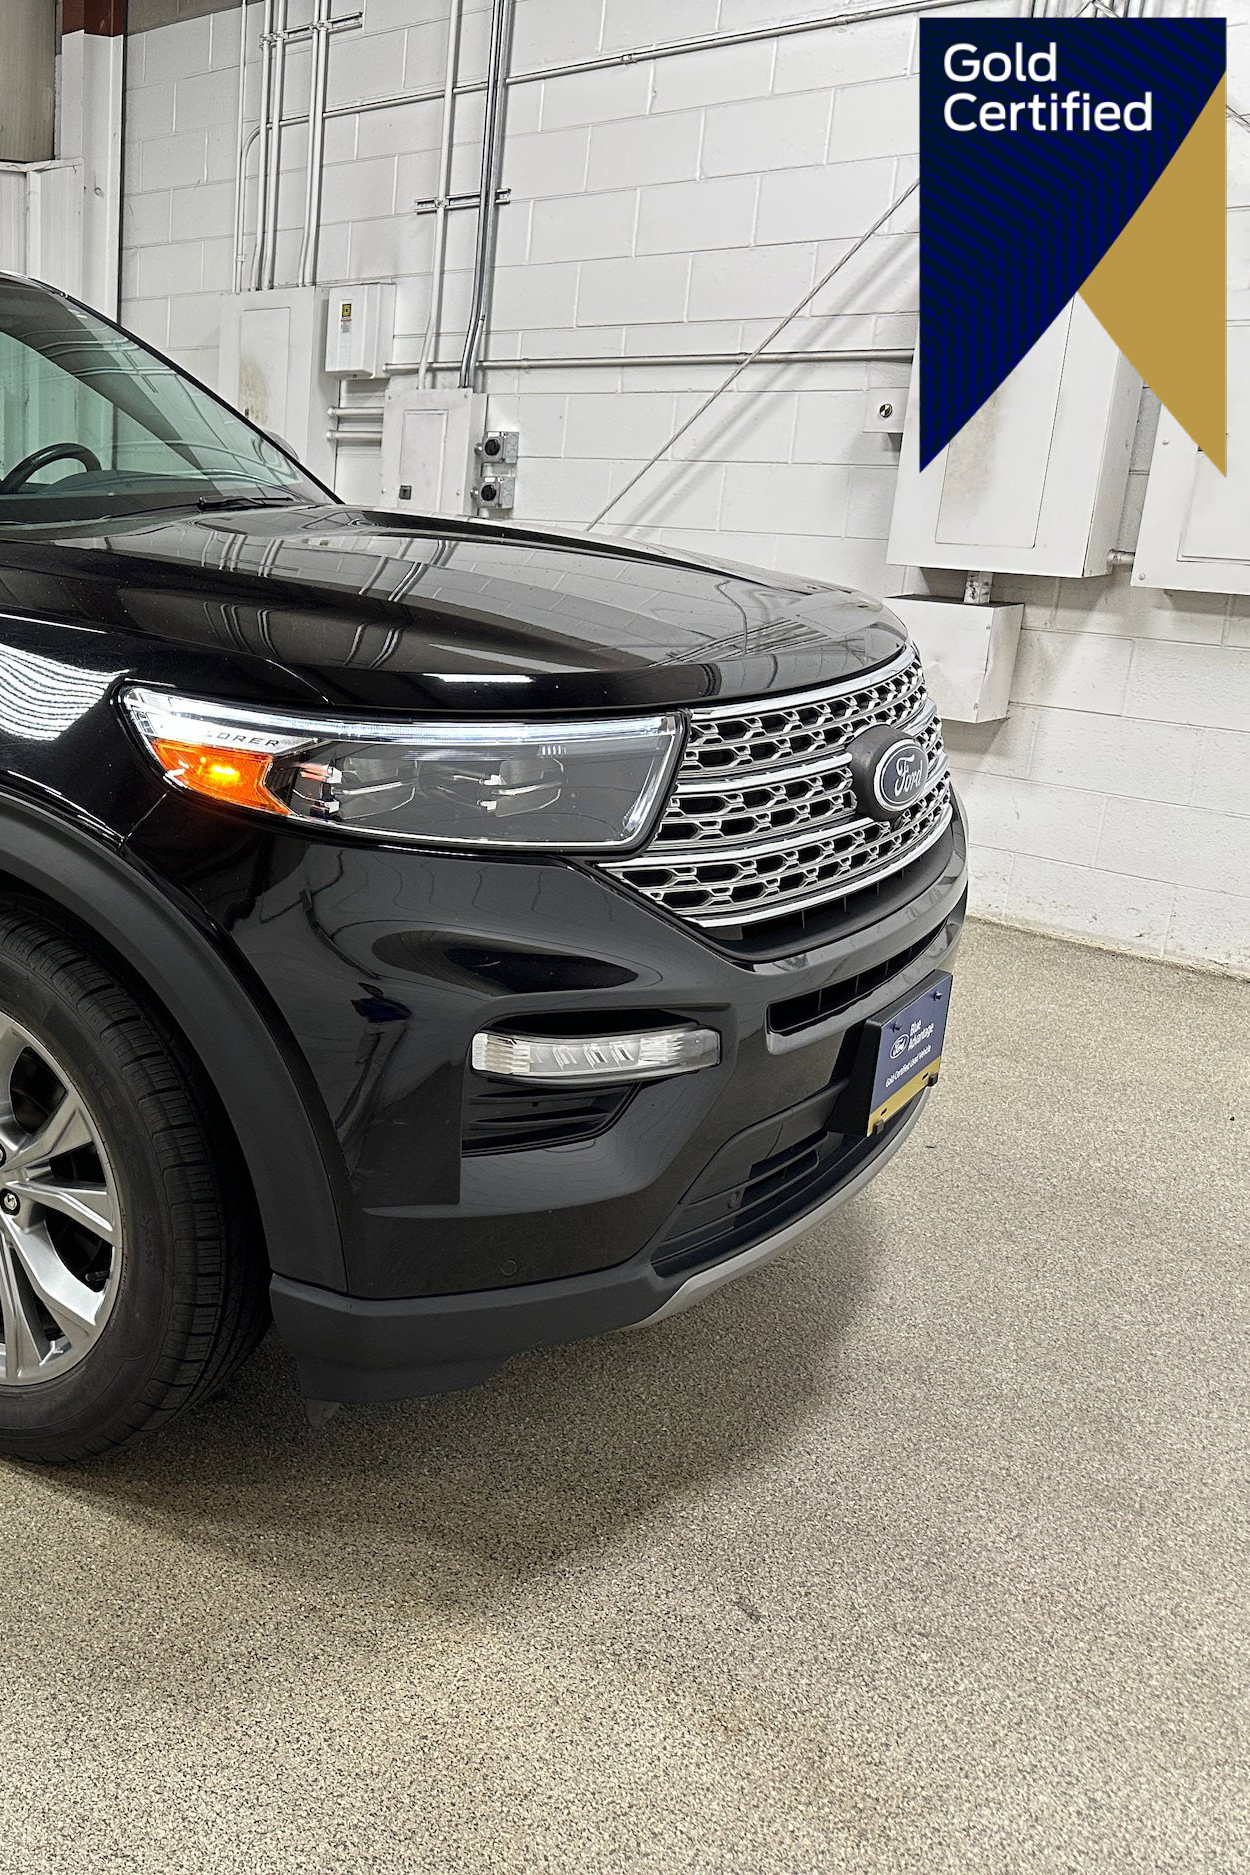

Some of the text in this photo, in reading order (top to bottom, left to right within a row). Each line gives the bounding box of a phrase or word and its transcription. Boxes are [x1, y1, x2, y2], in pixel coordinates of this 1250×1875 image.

[894, 754, 923, 797] Ford
[908, 1023, 934, 1051] Advantage
[910, 1020, 921, 1037] Blue
